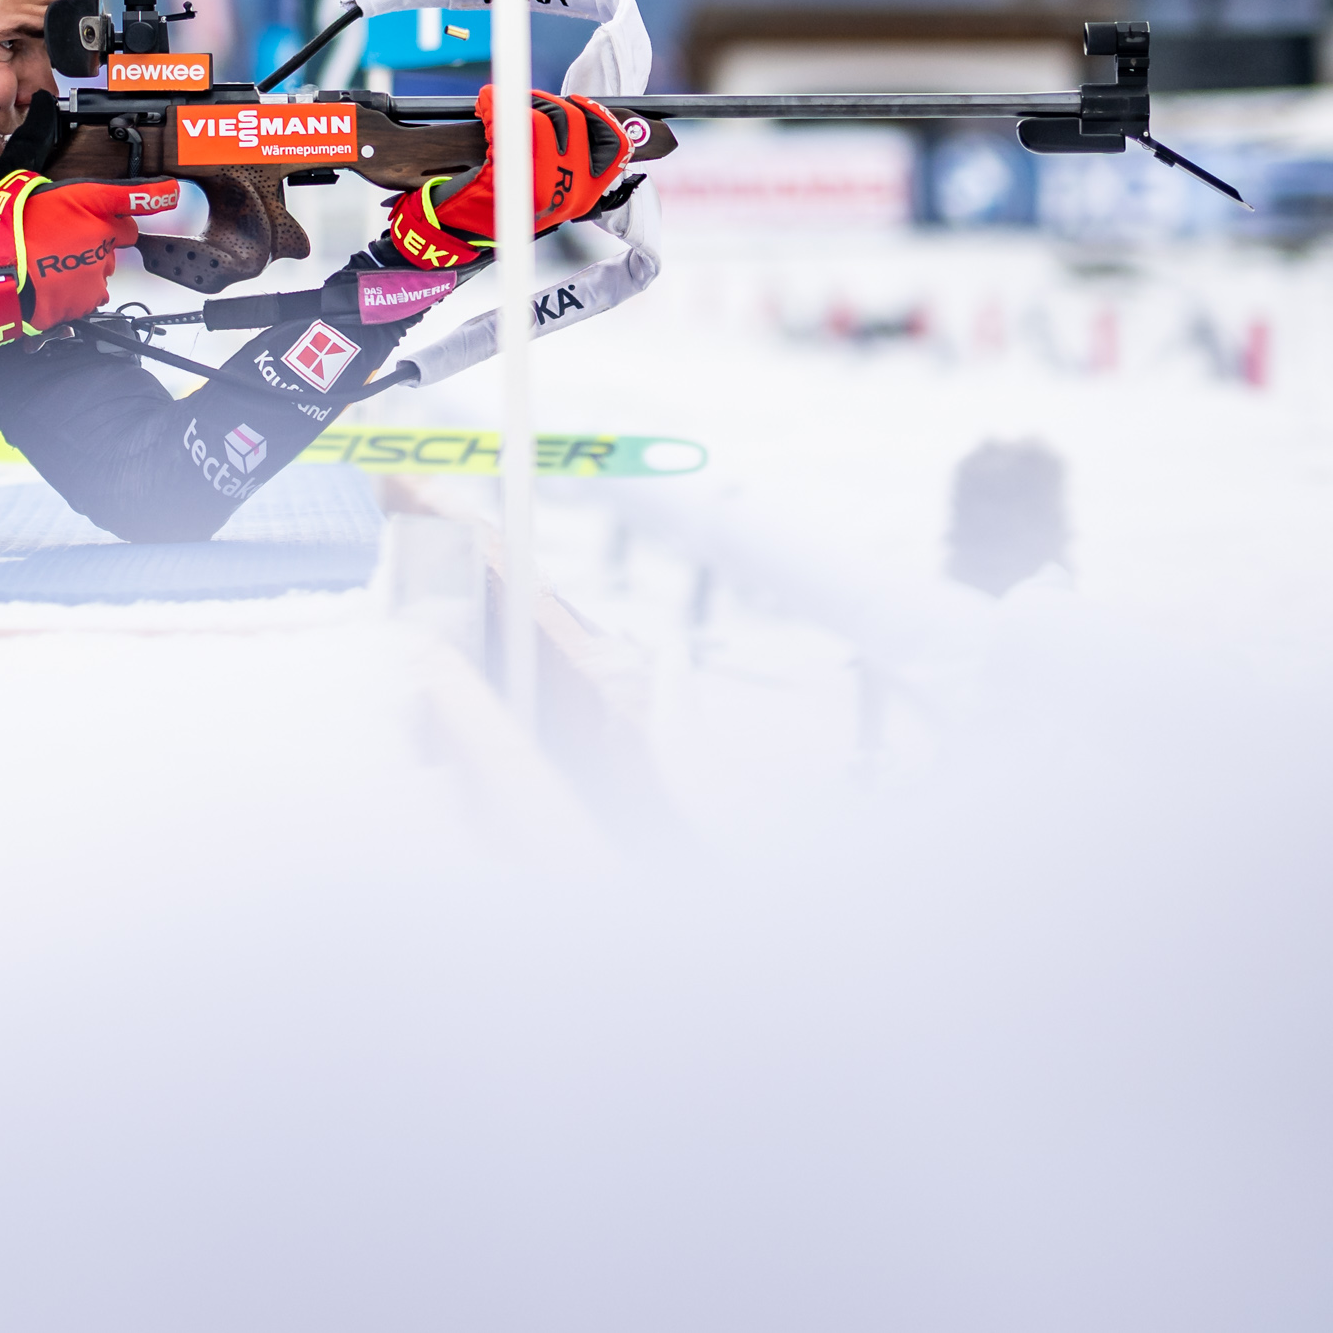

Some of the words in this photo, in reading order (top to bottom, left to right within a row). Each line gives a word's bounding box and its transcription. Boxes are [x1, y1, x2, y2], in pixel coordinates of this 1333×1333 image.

[111, 63, 206, 81] newkee
[182, 109, 351, 148] VIESSMANN
[261, 145, 352, 157] Wärmepumpen
[394, 213, 459, 267] LEKI
[363, 287, 383, 295] DAS
